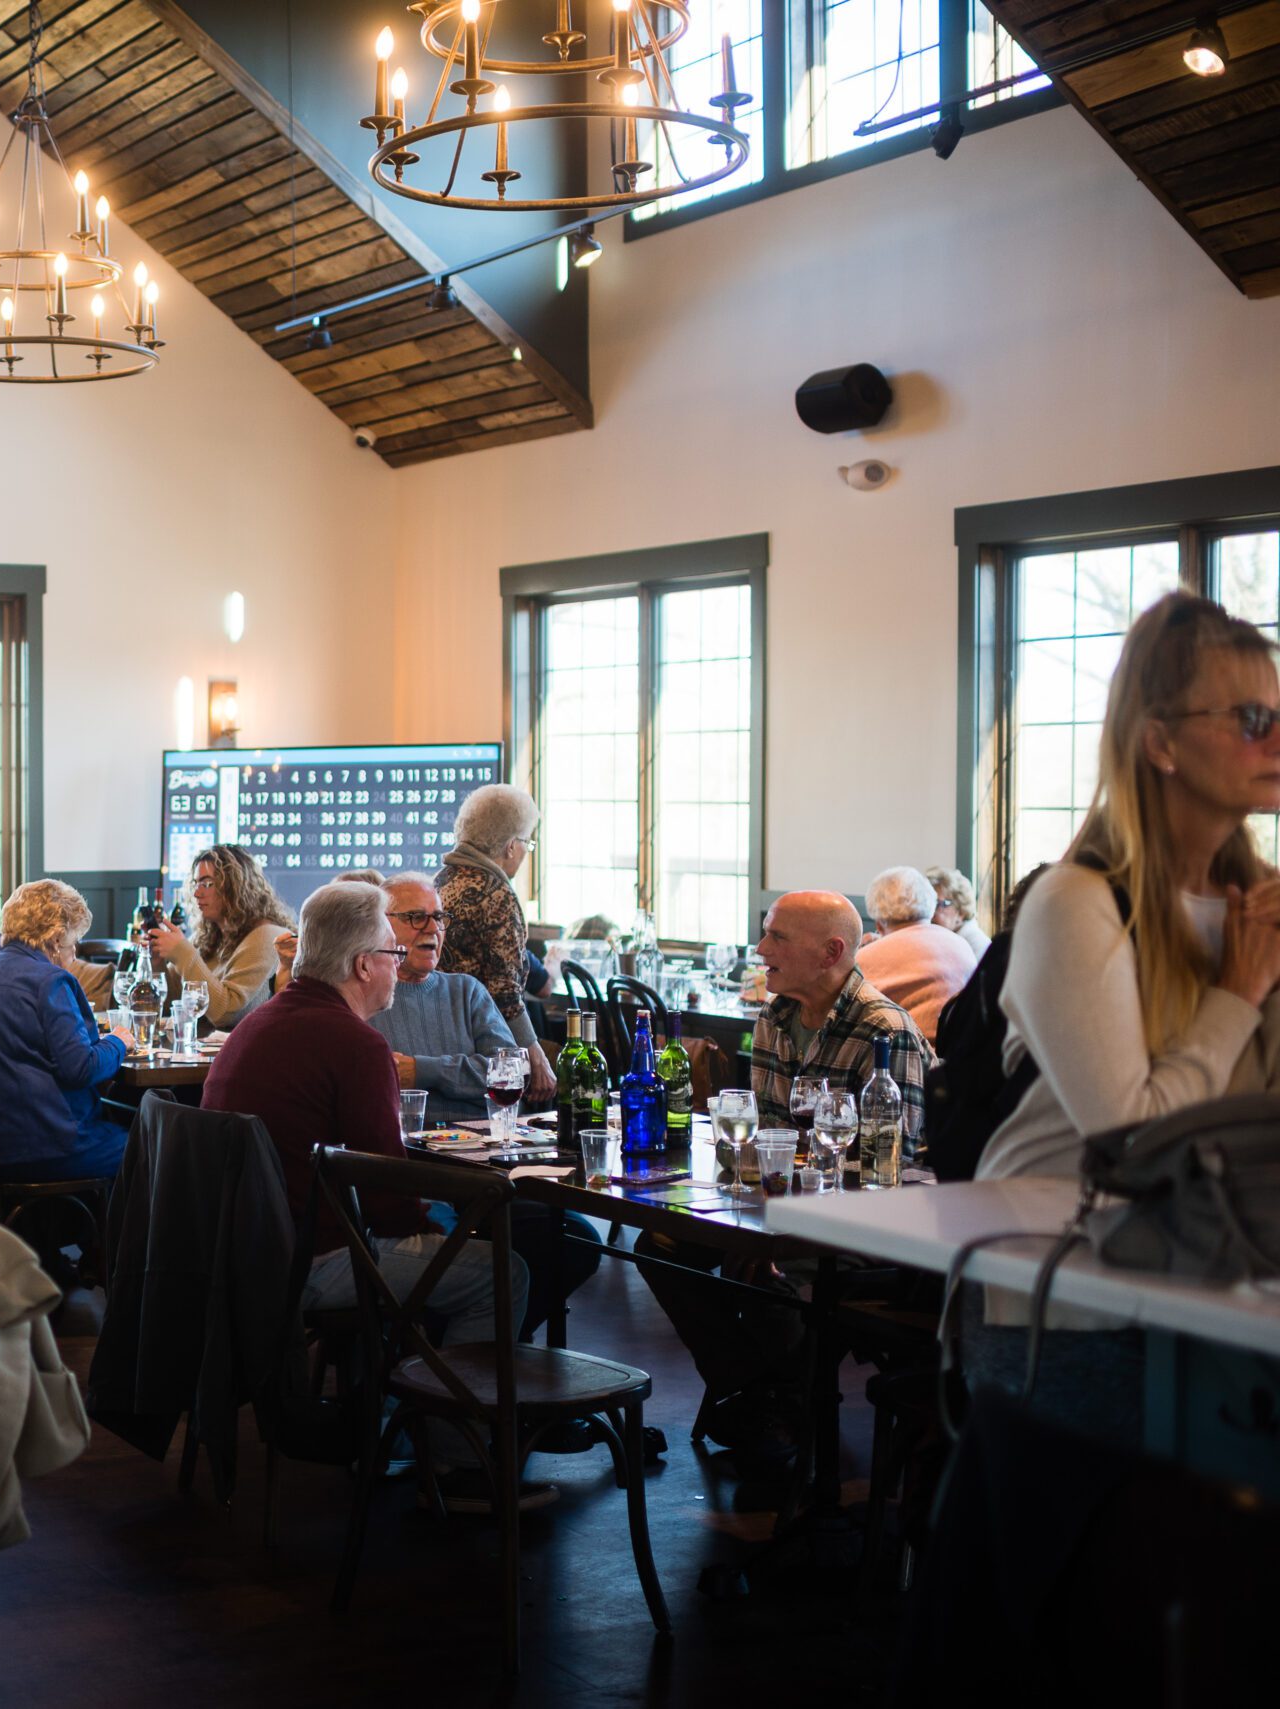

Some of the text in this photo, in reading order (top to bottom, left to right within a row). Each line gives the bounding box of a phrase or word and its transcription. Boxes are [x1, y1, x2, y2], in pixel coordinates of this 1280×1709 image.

[243, 772, 248, 784] 1
[258, 772, 266, 784] 2
[291, 771, 299, 784] 4
[309, 771, 316, 784] 5
[325, 771, 332, 784] 6
[342, 770, 349, 784] 7
[358, 770, 366, 784] 8
[376, 770, 383, 783] 9
[390, 769, 403, 782] 10
[408, 769, 419, 781] 11
[425, 769, 438, 782] 12
[442, 768, 455, 781] 13
[460, 768, 473, 781] 14
[478, 768, 491, 781] 15
[171, 795, 190, 812] 63
[196, 795, 215, 812] 67
[240, 793, 252, 805] 16
[256, 792, 269, 804] 17
[272, 792, 285, 805] 18
[289, 792, 302, 804] 19
[305, 792, 318, 804] 20
[321, 791, 334, 804] 21
[338, 791, 352, 804] 22
[355, 791, 369, 804] 23
[389, 790, 403, 803] 25
[406, 790, 421, 803] 26
[424, 790, 438, 803] 27
[441, 790, 455, 803] 28
[239, 813, 250, 826] 31
[255, 813, 268, 826] 32
[271, 813, 284, 825] 33
[288, 813, 301, 825] 34
[321, 812, 335, 825] 36
[338, 812, 352, 825] 37
[355, 812, 369, 825] 38
[372, 812, 386, 825] 39
[406, 812, 419, 824] 41
[423, 811, 438, 824] 42
[238, 834, 251, 846] 46
[254, 833, 268, 846] 47
[270, 833, 284, 846] 48
[287, 833, 301, 846] 49
[321, 833, 333, 846] 51
[338, 833, 351, 846] 52
[355, 833, 368, 846] 53
[372, 833, 385, 846] 54
[389, 833, 403, 846] 55
[423, 832, 437, 845] 57
[287, 855, 300, 867] 64
[320, 854, 334, 867] 66
[337, 854, 351, 868] 67
[354, 854, 368, 867] 68
[389, 854, 402, 867] 70
[423, 854, 437, 867] 72
